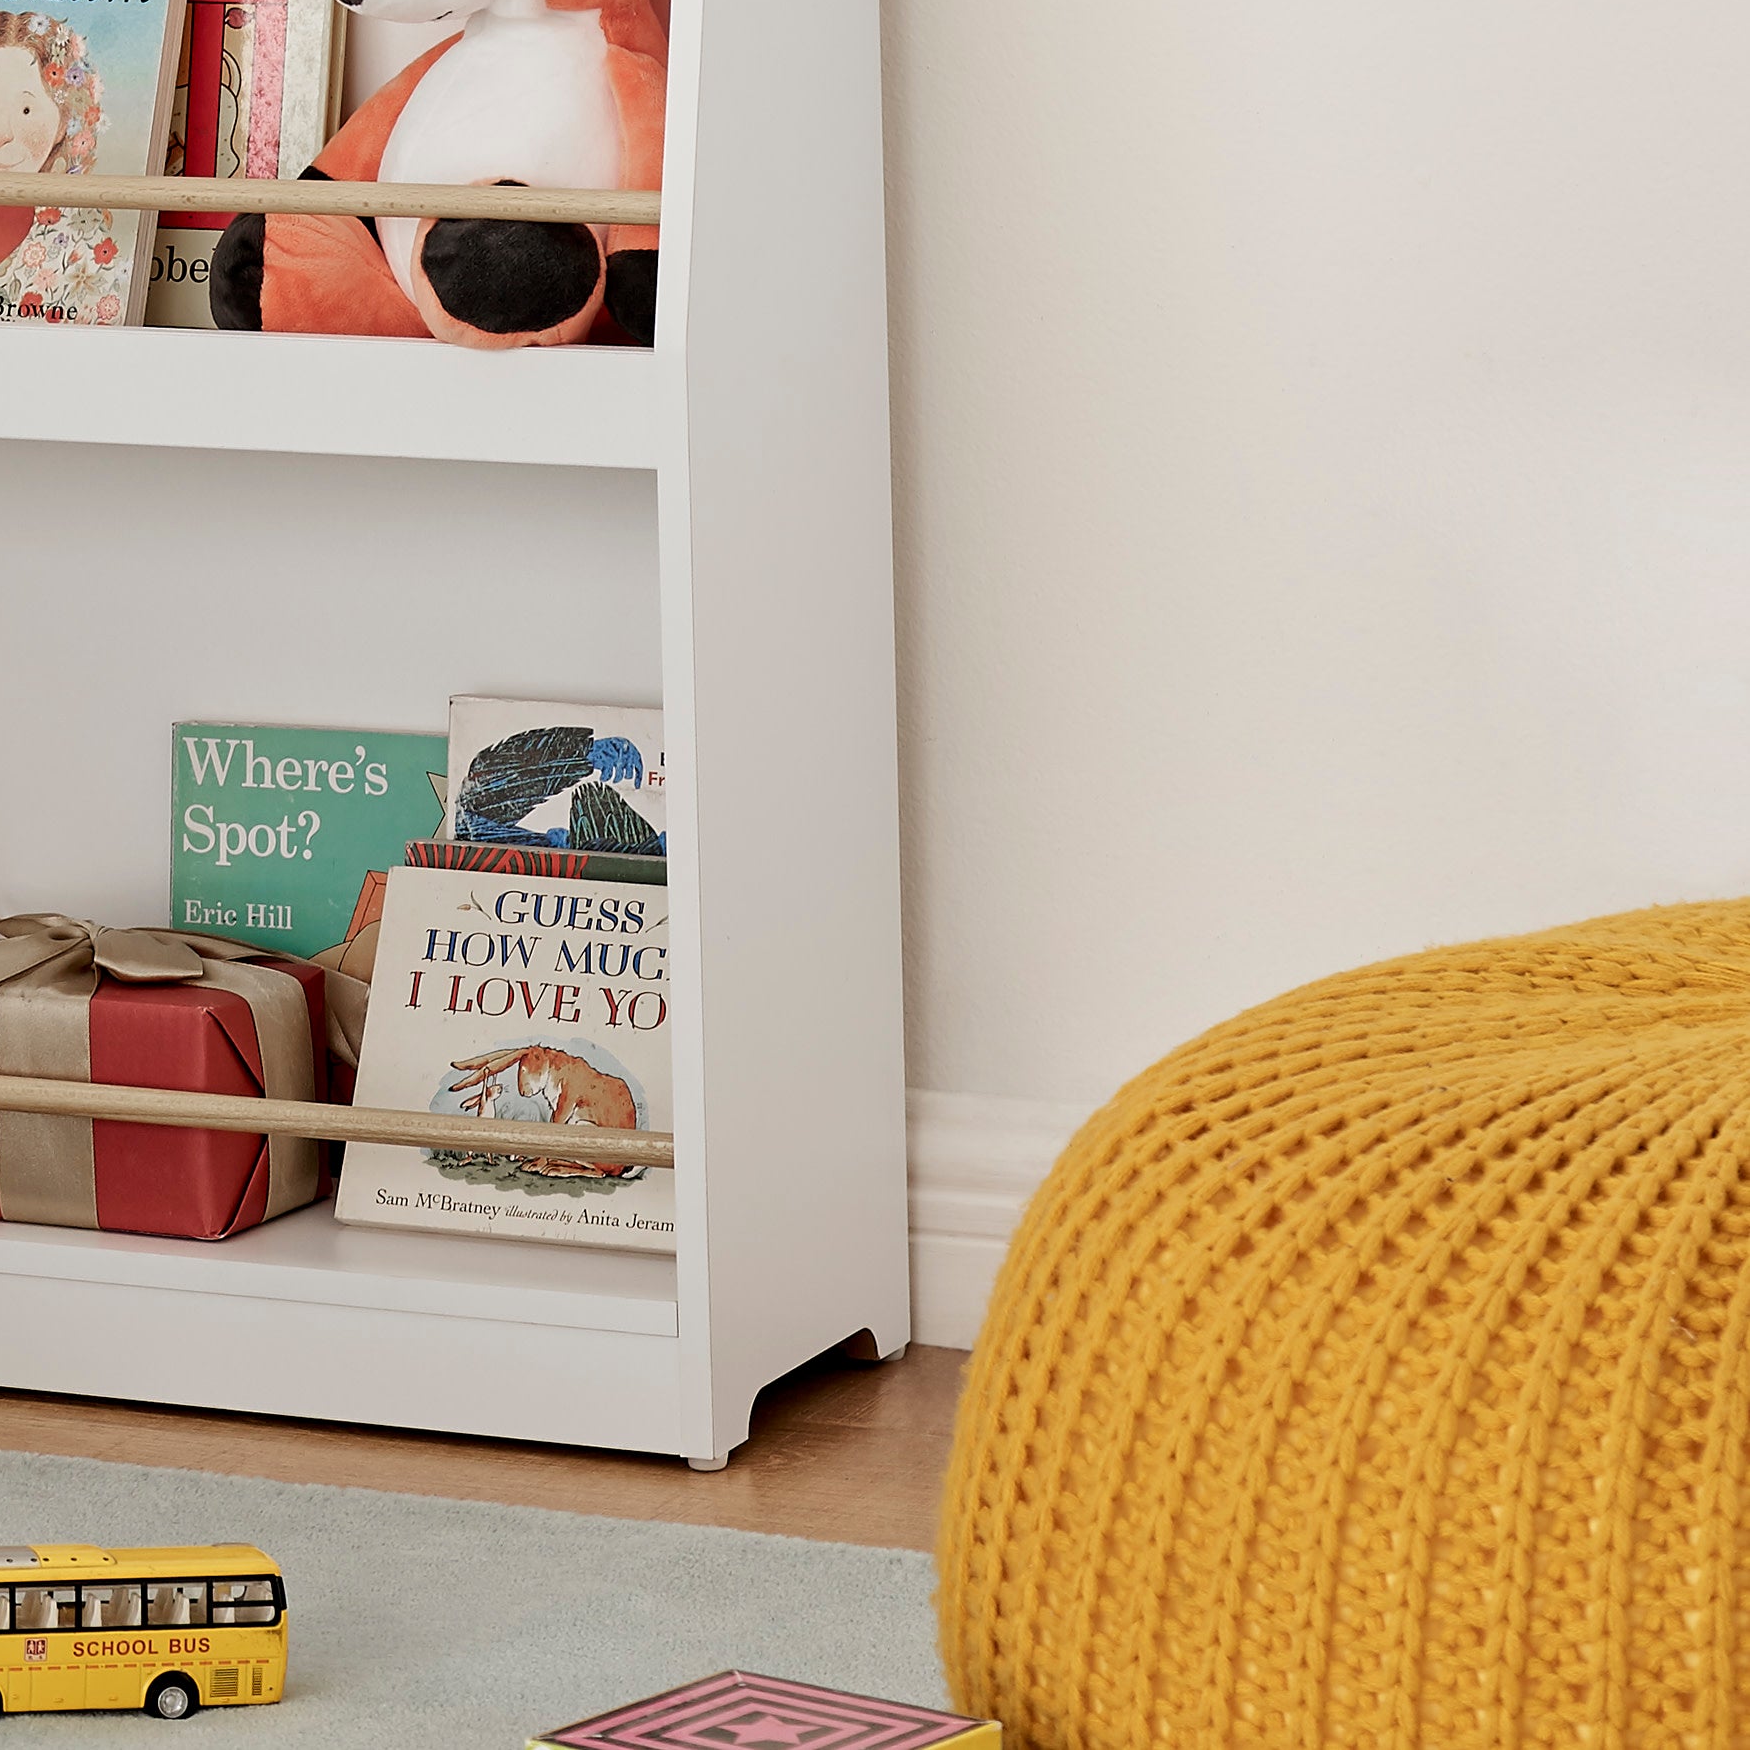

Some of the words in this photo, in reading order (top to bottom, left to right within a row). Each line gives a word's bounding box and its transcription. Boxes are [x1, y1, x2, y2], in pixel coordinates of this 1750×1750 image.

[182, 737, 389, 796] Where's
[649, 771, 665, 786] Fr
[183, 804, 321, 866] Spot?
[184, 899, 237, 926] Eric
[246, 903, 293, 930] Hill
[495, 890, 645, 934] GUESS
[421, 928, 542, 969] HOW
[554, 939, 670, 981] MUC
[405, 971, 426, 1010] I
[443, 975, 581, 1024] LOVE
[598, 987, 667, 1031] YO
[375, 1188, 409, 1207] Sam
[415, 1192, 502, 1220] McBratney
[504, 1205, 558, 1221] illustrated
[560, 1212, 573, 1225] by
[576, 1208, 620, 1228] Anita
[626, 1213, 675, 1232] Jeram
[73, 1639, 159, 1657] SCHOOL
[169, 1637, 211, 1654] BUS
